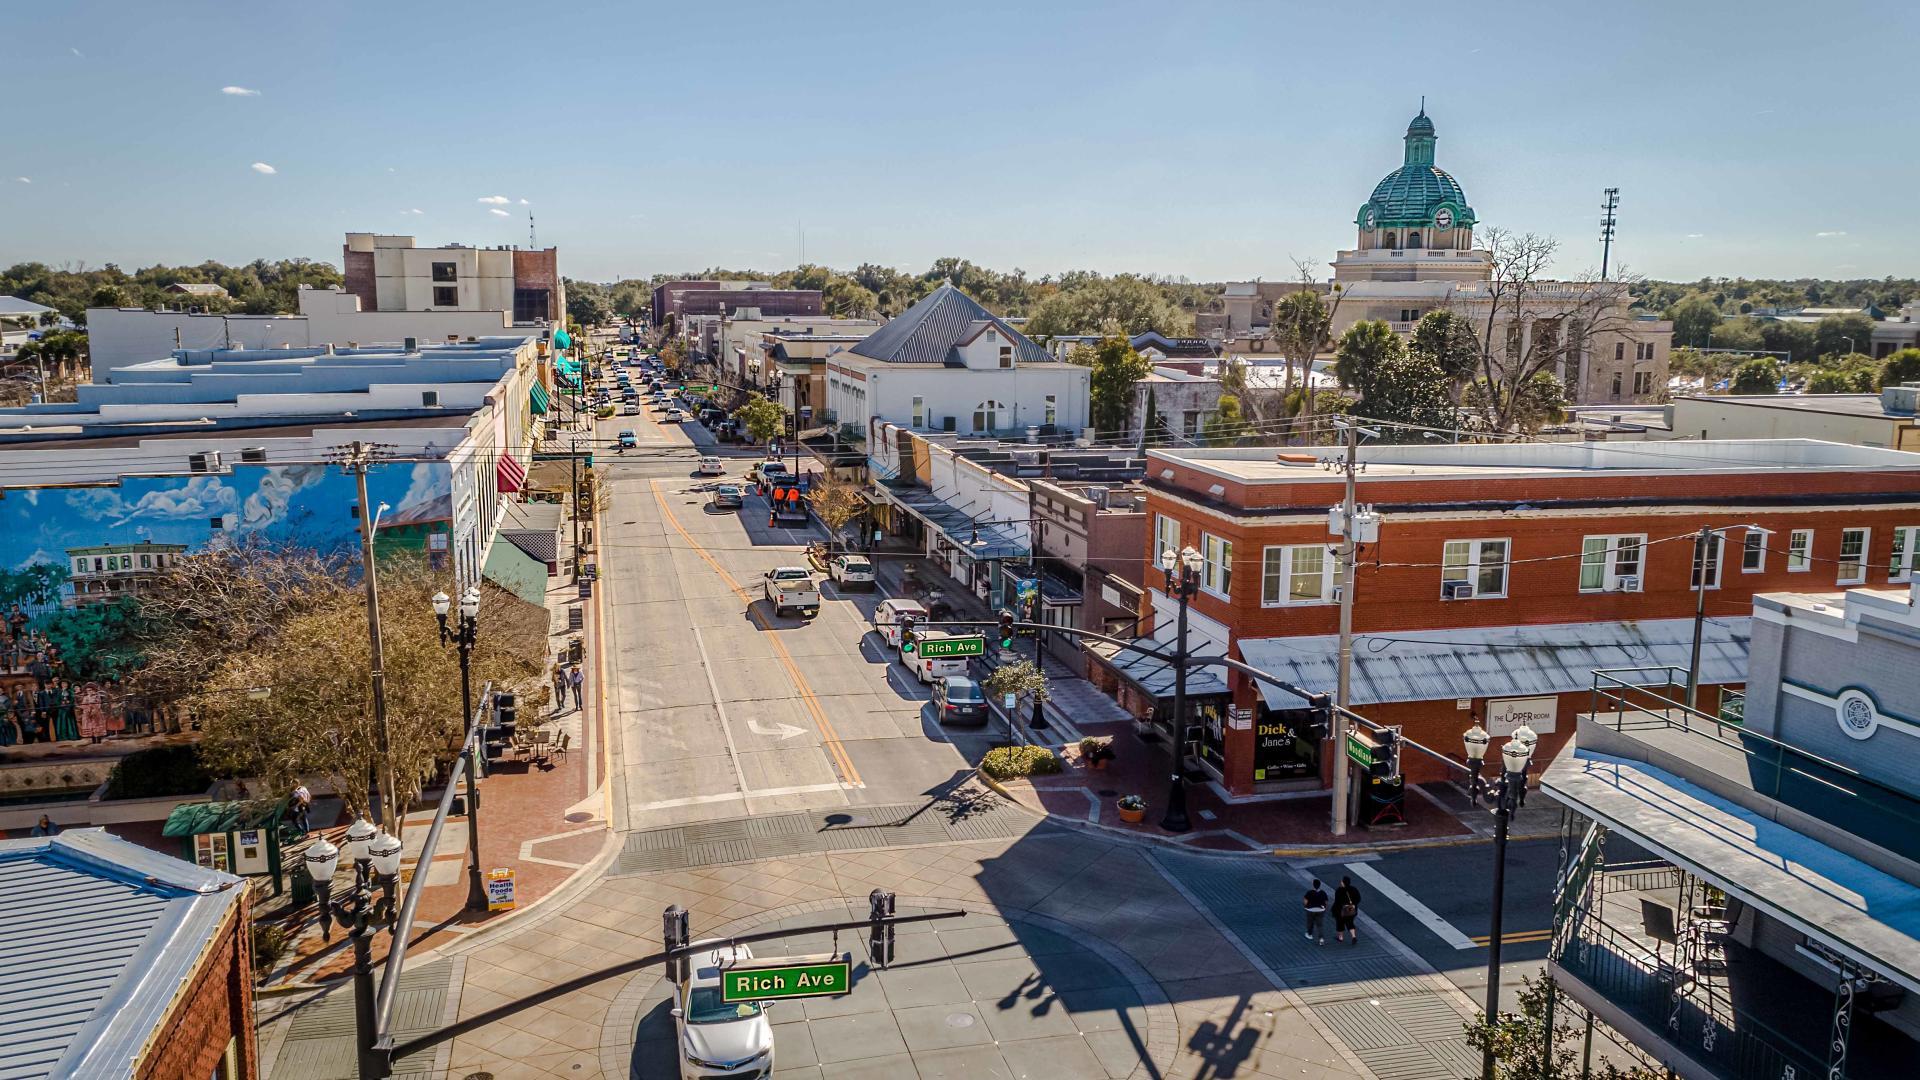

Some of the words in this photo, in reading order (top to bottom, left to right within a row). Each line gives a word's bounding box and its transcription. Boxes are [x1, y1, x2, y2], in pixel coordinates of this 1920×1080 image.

[927, 644, 951, 653] Rich
[957, 643, 976, 651] Ave
[1505, 712, 1533, 723] UPPER
[1258, 723, 1287, 736] Dick
[1287, 728, 1297, 738] &
[1262, 736, 1291, 747] Jane's
[737, 975, 785, 992] Rich
[797, 972, 835, 987] Ave
